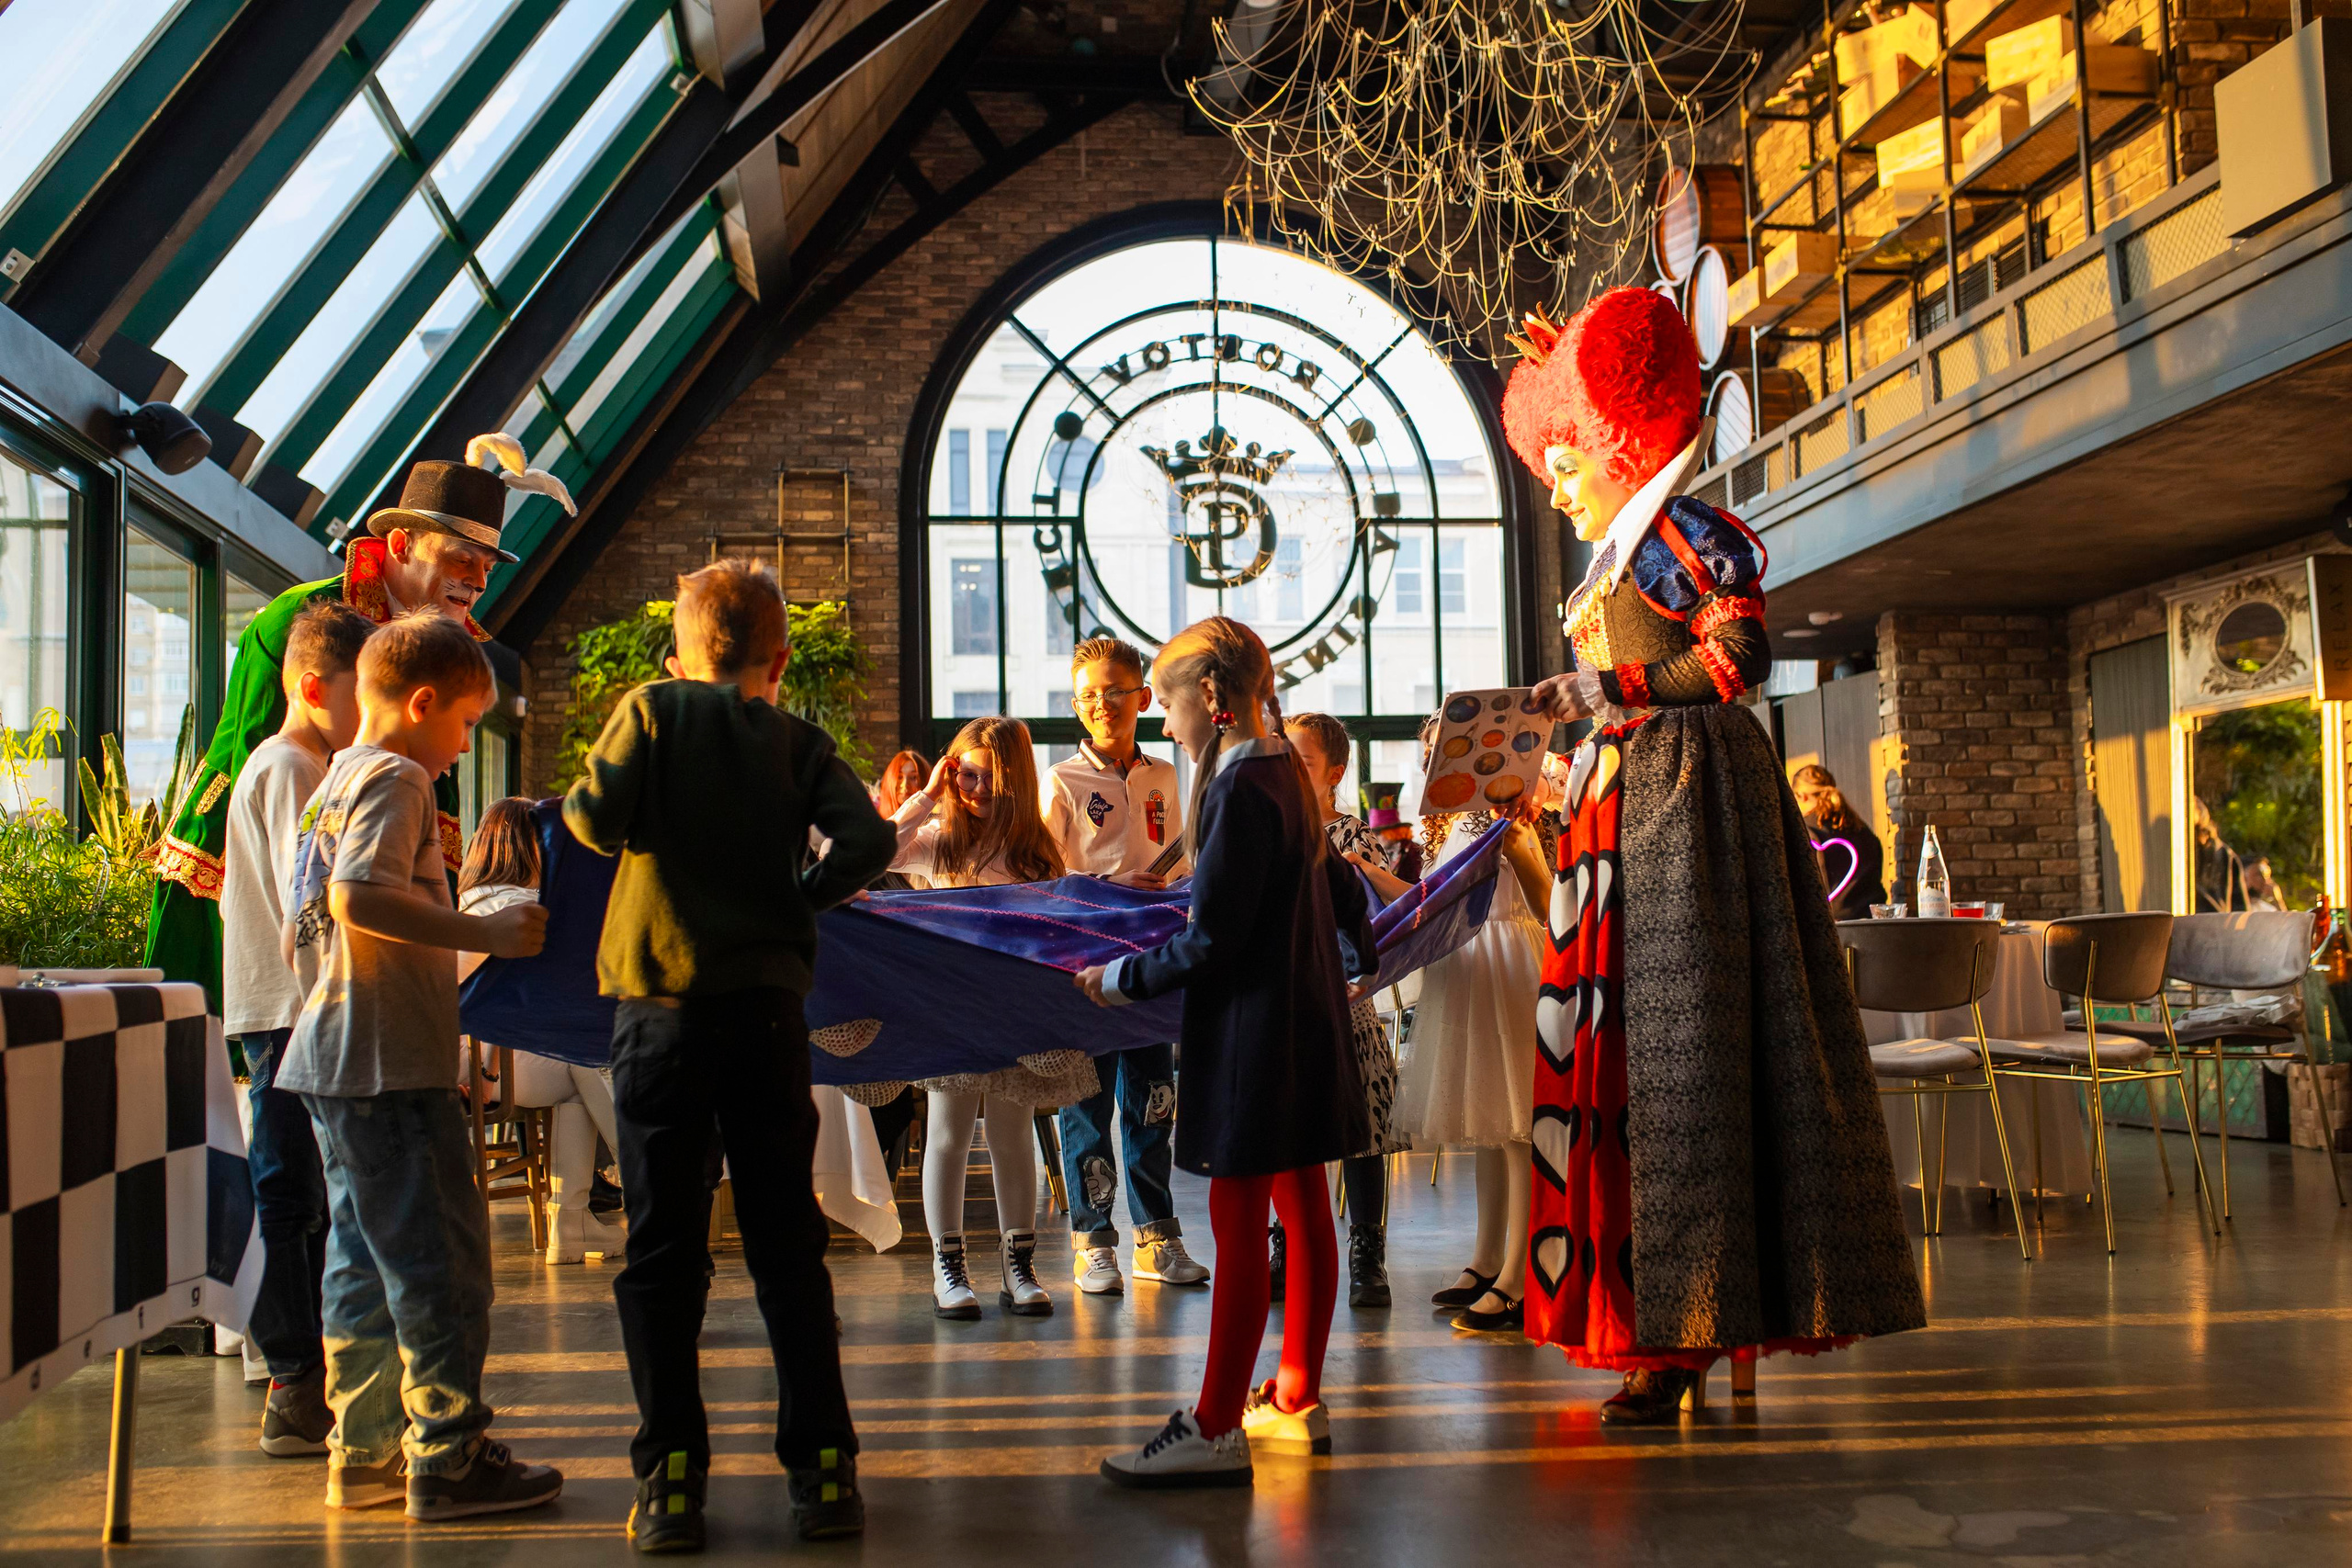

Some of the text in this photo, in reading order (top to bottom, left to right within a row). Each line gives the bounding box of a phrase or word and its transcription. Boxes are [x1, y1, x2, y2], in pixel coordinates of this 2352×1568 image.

[2328, 582, 2351, 672] RELAX
[137, 1304, 145, 1330] f
[190, 1286, 201, 1308] g
